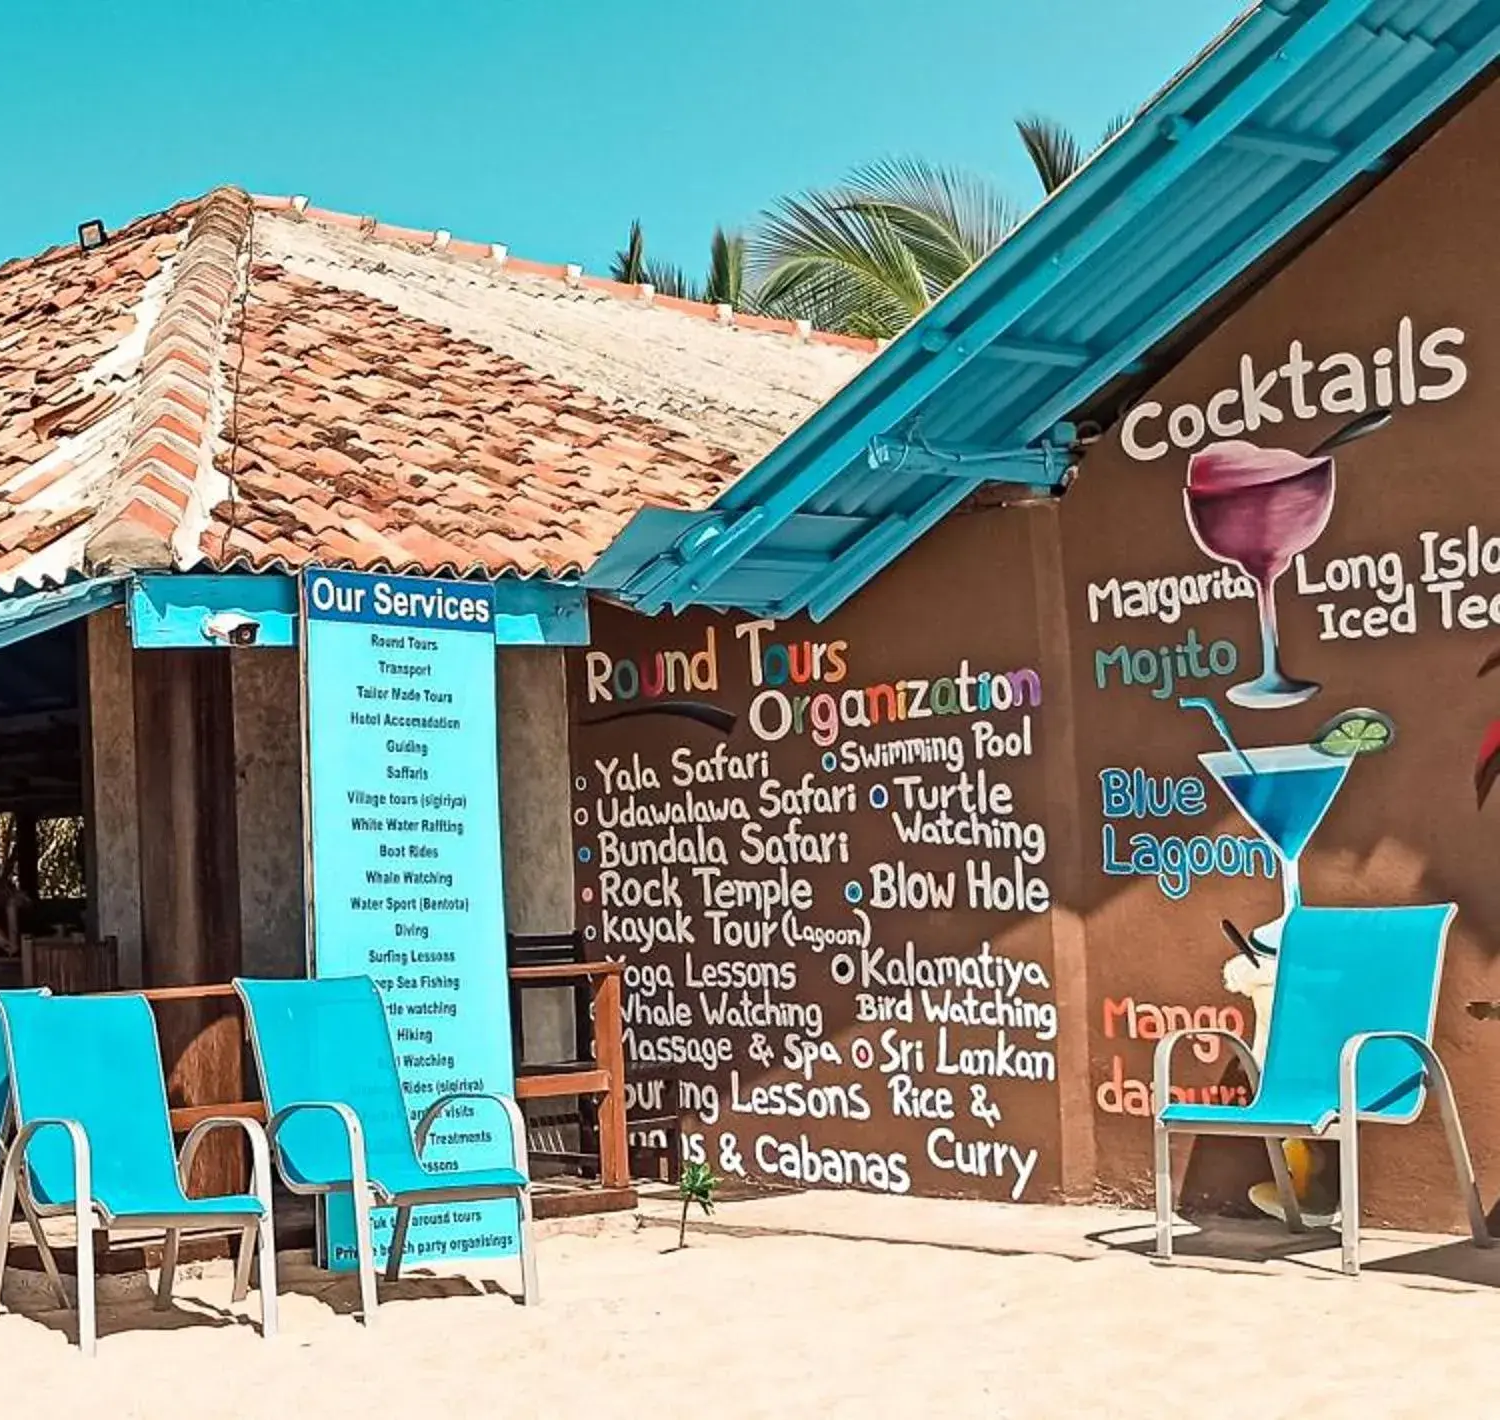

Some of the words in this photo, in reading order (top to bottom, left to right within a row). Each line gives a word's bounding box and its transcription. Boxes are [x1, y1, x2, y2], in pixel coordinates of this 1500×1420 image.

[1120, 315, 1469, 461] Cocktails
[312, 576, 366, 612] Our
[373, 582, 490, 623] Services
[1087, 566, 1256, 624] Margarita
[1296, 552, 1404, 603] Long
[1317, 583, 1416, 641] Iced
[371, 633, 405, 649] Round
[407, 636, 439, 651] Tours
[586, 626, 718, 703] Round
[735, 620, 848, 687] Tours
[1095, 628, 1237, 698] Mojito
[378, 660, 432, 678] Transport
[356, 685, 389, 699] Tailor
[391, 687, 421, 701] Made
[423, 689, 454, 704] Tours
[748, 659, 1043, 746] Organization
[350, 712, 381, 726] Hotel
[386, 739, 429, 757] Guiding
[840, 733, 964, 773] Swimming
[971, 715, 1032, 759] Pool
[386, 765, 429, 780] Saffaris
[595, 756, 660, 796] Yala
[671, 742, 769, 787] Safari
[893, 769, 1013, 816] Turtle
[1099, 767, 1207, 817] Blue
[347, 791, 387, 808] Village
[389, 792, 419, 805] tours
[597, 795, 751, 830] Udawalawa
[758, 772, 857, 820] Safari
[351, 817, 383, 832] White
[386, 818, 420, 832] Water
[597, 824, 729, 868] Bundala
[739, 818, 850, 865] Safari
[891, 807, 1046, 864] Watching
[379, 844, 407, 858] Boat
[409, 844, 439, 859] Rides
[1102, 824, 1277, 899] Lagoon
[366, 870, 401, 884] Whale
[402, 871, 453, 888] Watching
[598, 866, 684, 908] Rock
[691, 866, 813, 920] Temple
[869, 861, 955, 910] Blow
[966, 855, 1051, 913] Hole
[350, 896, 383, 911] Water
[385, 898, 417, 913] Sport
[395, 923, 429, 939] Diving
[368, 949, 408, 966] Surfing
[410, 949, 456, 963] Lessons
[685, 952, 797, 990] Lessons
[860, 941, 1050, 997] Kalamatiya
[396, 975, 419, 989] Sea
[420, 975, 461, 991] Fishing
[406, 1000, 458, 1017] watching
[699, 989, 823, 1038] Watching
[855, 988, 913, 1023] Bird
[920, 988, 1058, 1041] Watching
[1103, 996, 1245, 1063] Mango
[397, 1027, 433, 1044] Hiking
[748, 1032, 775, 1068] &
[783, 1033, 842, 1081] Spa
[879, 1027, 924, 1075] Sri
[935, 1026, 1055, 1082] Lankan
[402, 1053, 455, 1069] Watching
[402, 1080, 434, 1094] Rides
[731, 1070, 871, 1120] Lessons
[887, 1074, 955, 1119] Rice
[970, 1083, 1000, 1128] &
[444, 1104, 475, 1119] visits
[429, 1130, 493, 1146] Treatments
[422, 1160, 459, 1173] ssons
[719, 1132, 748, 1177] &
[754, 1135, 911, 1194] Cabanas
[926, 1126, 1038, 1201] Curry
[411, 1211, 451, 1228] around
[453, 1210, 483, 1224] tours
[417, 1238, 448, 1256] party
